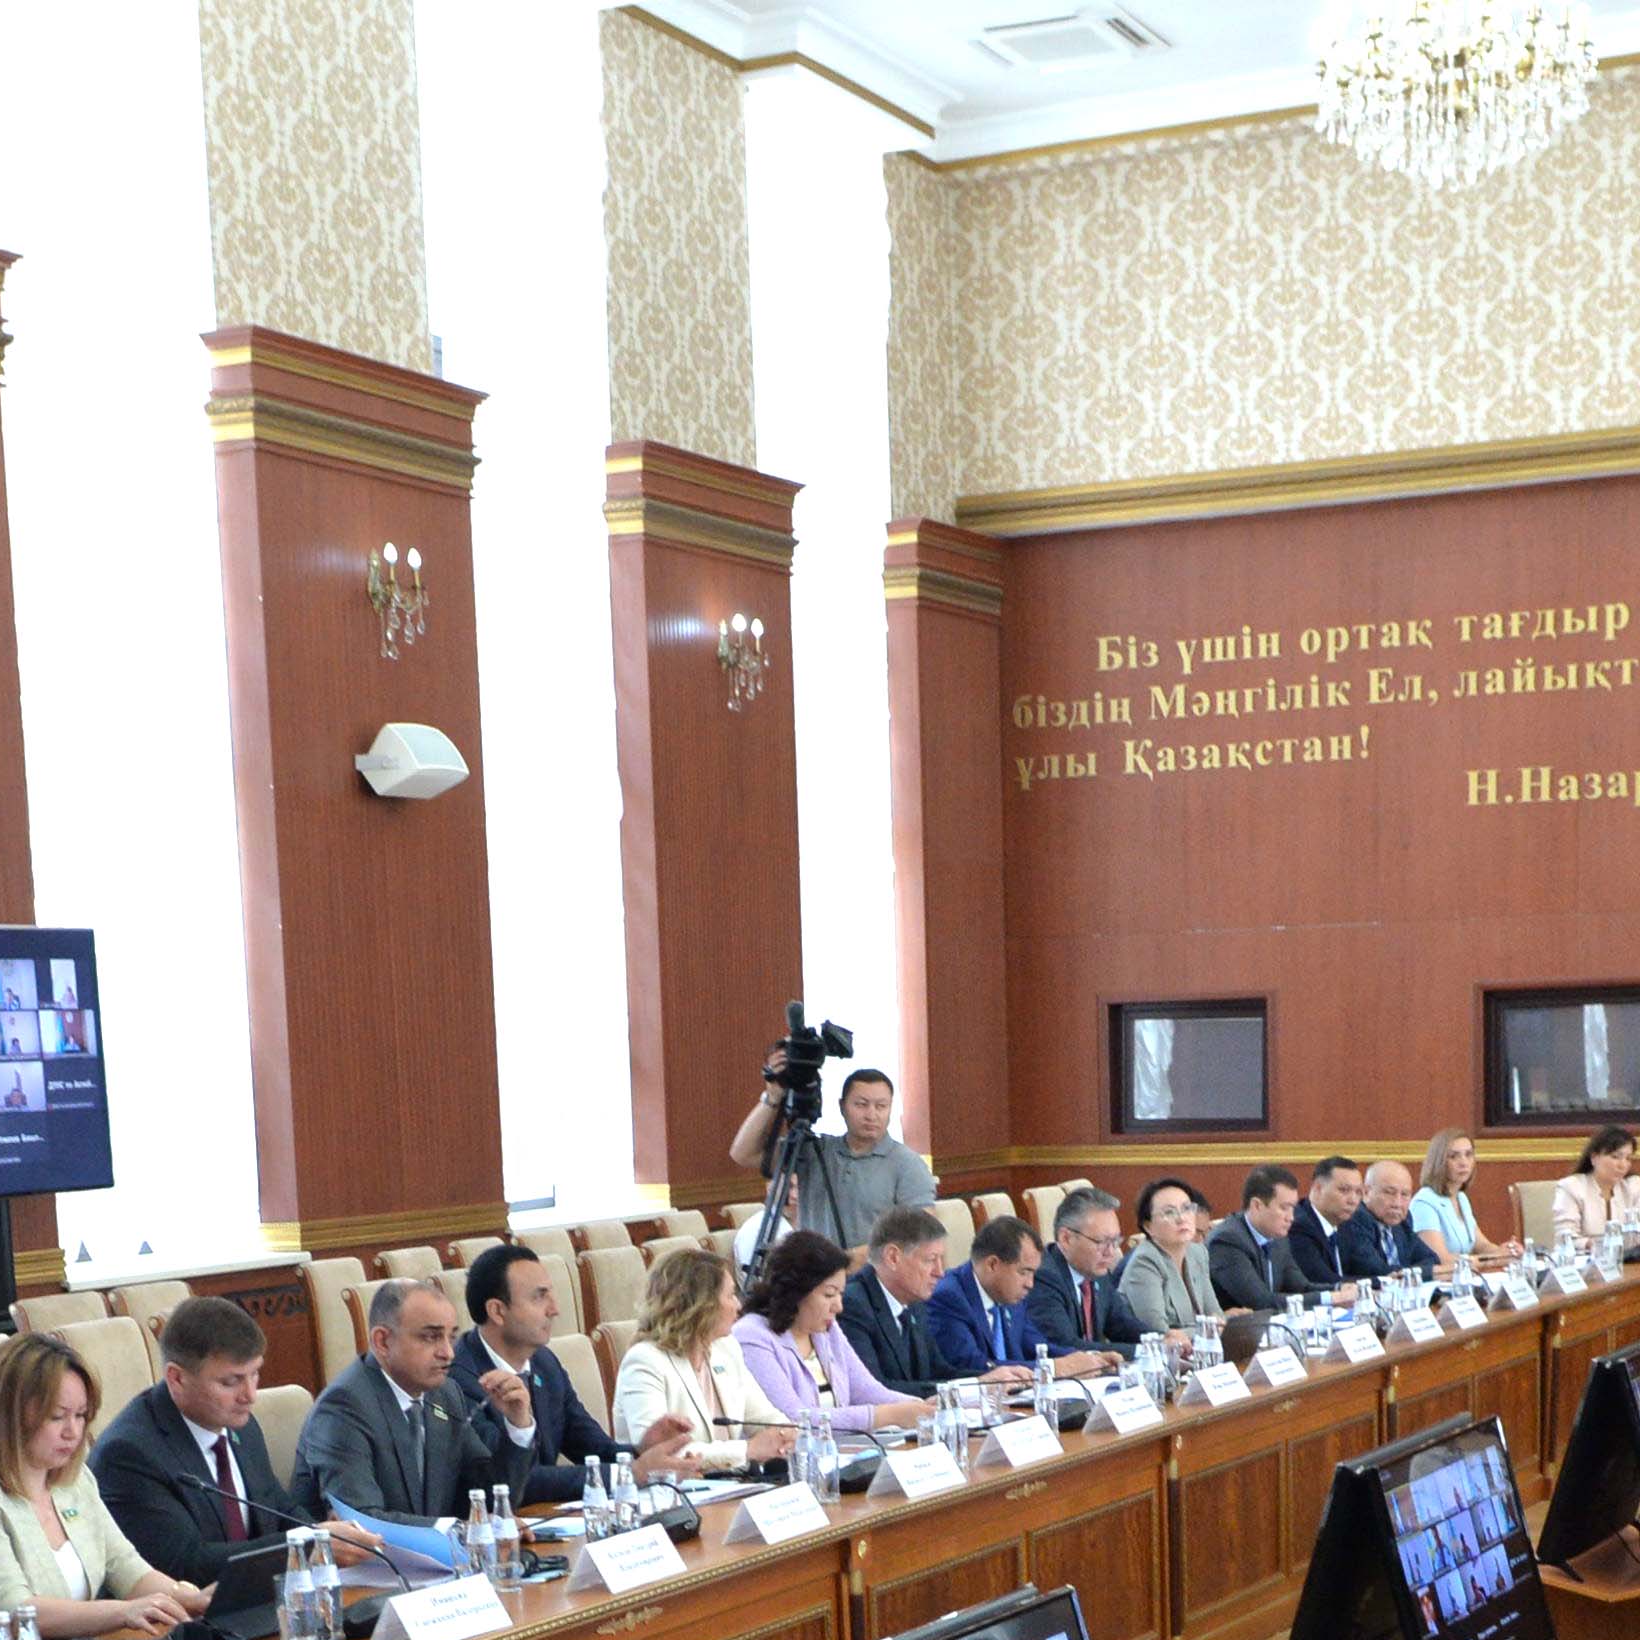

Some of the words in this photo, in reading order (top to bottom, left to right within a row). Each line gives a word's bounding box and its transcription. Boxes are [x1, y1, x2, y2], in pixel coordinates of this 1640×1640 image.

[1096, 634, 1161, 674] Біз
[1176, 625, 1282, 676] үшін
[1299, 614, 1434, 658] ортақ
[1453, 599, 1632, 644] тағдыр
[1012, 688, 1133, 731] біздің
[1148, 675, 1353, 727] Мәңгілік
[1367, 666, 1442, 708] Ел,
[1013, 751, 1099, 791] ұлы
[1122, 724, 1372, 782] Қазақстан!
